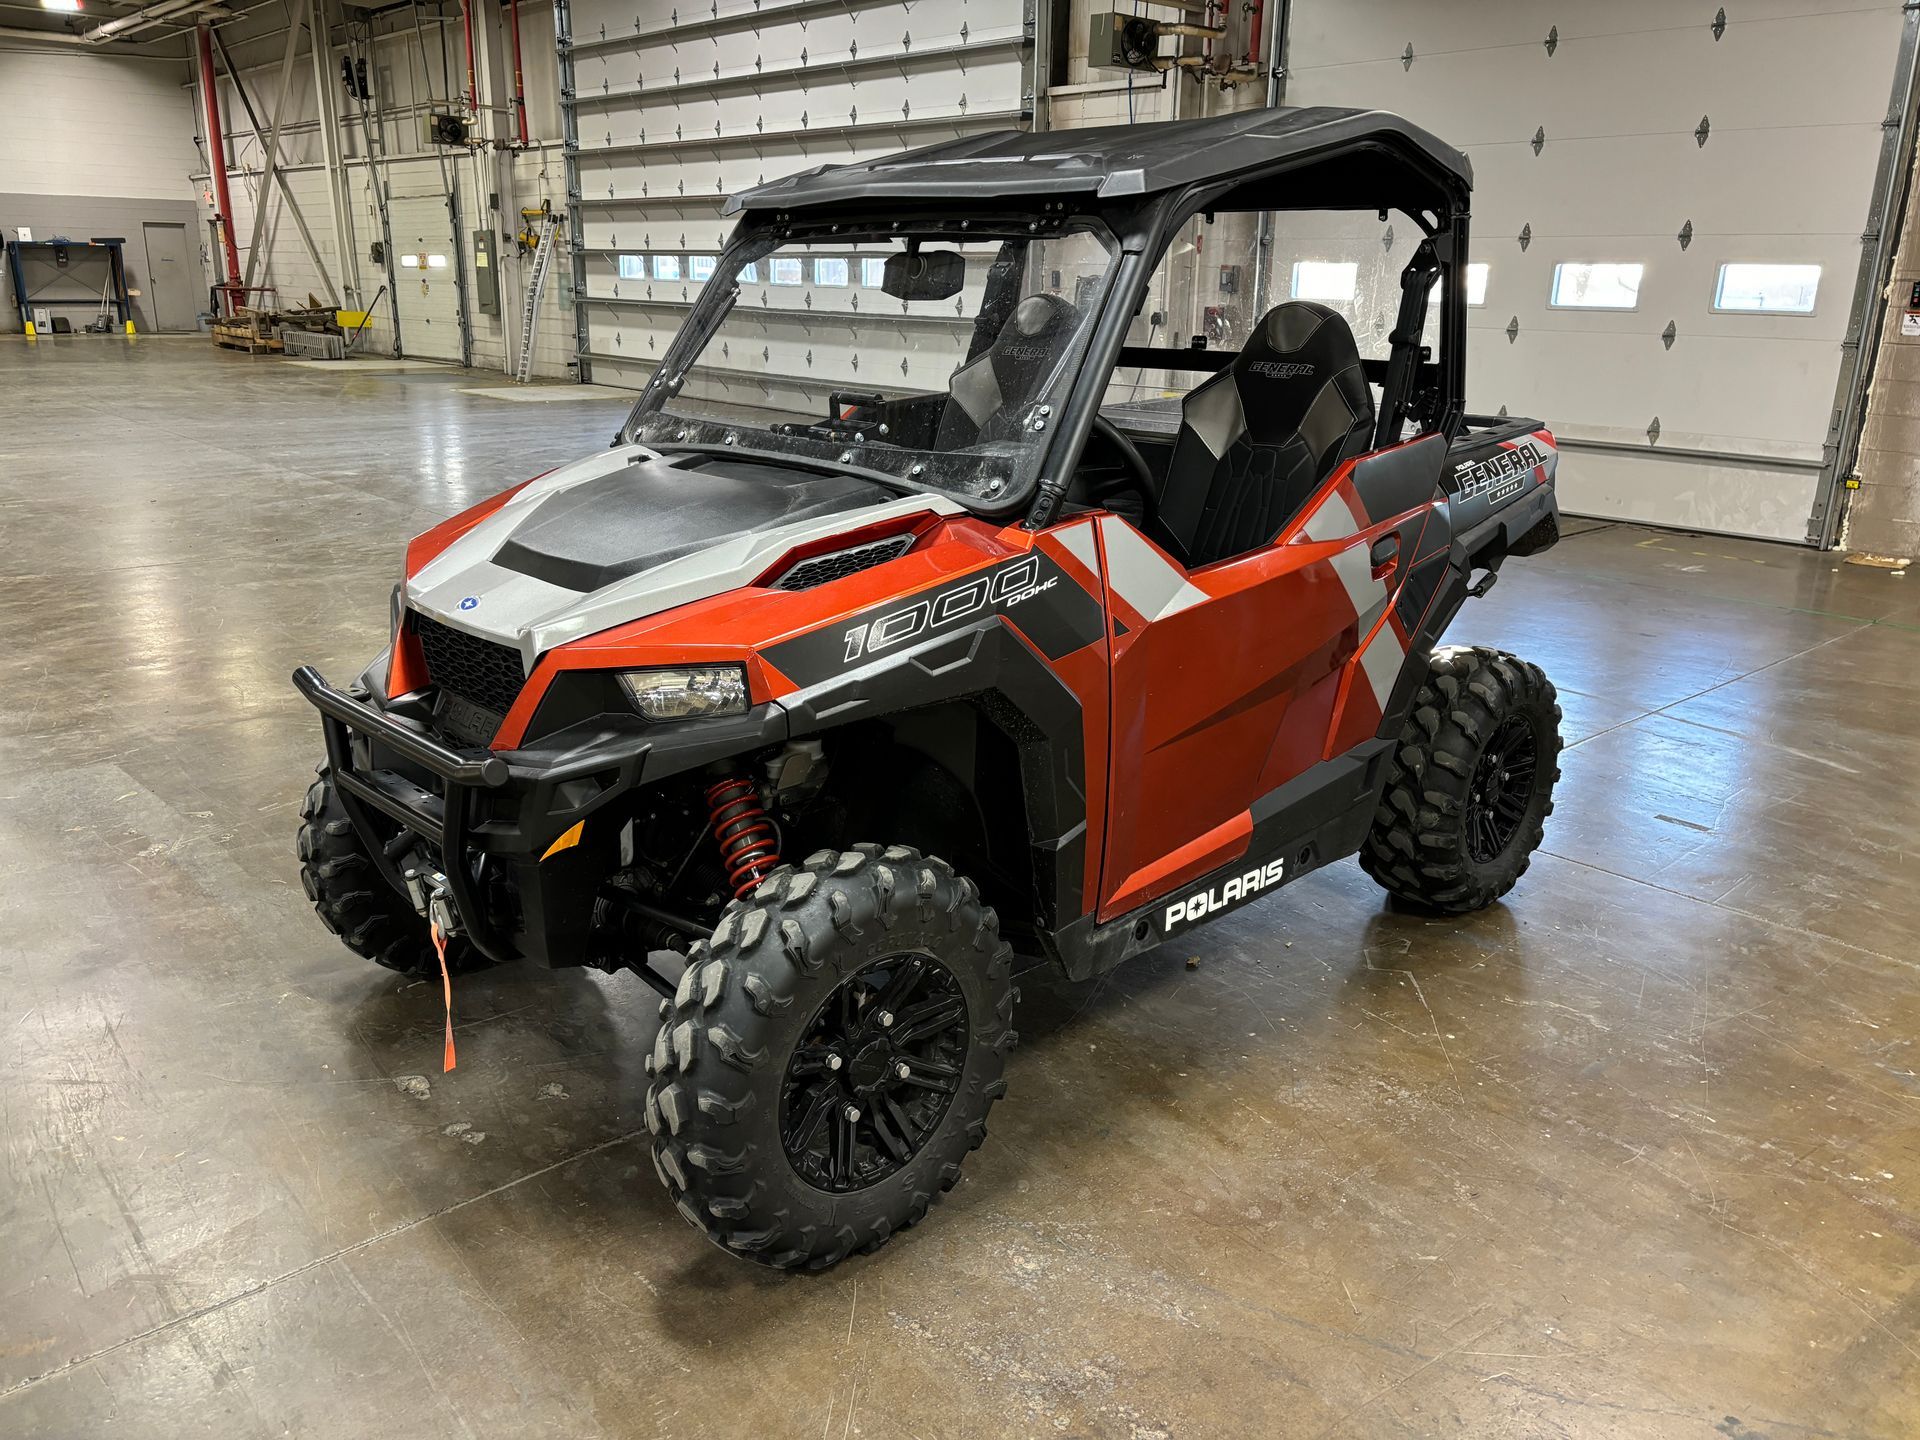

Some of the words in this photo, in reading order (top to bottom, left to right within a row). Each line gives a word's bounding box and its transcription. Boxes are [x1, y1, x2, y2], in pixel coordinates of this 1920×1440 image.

[1248, 361, 1316, 375] GENERAL
[1454, 441, 1549, 504] GENERAL
[844, 555, 1039, 663] 1000
[1006, 576, 1058, 607] DOHC
[1165, 857, 1284, 932] POLARIS
